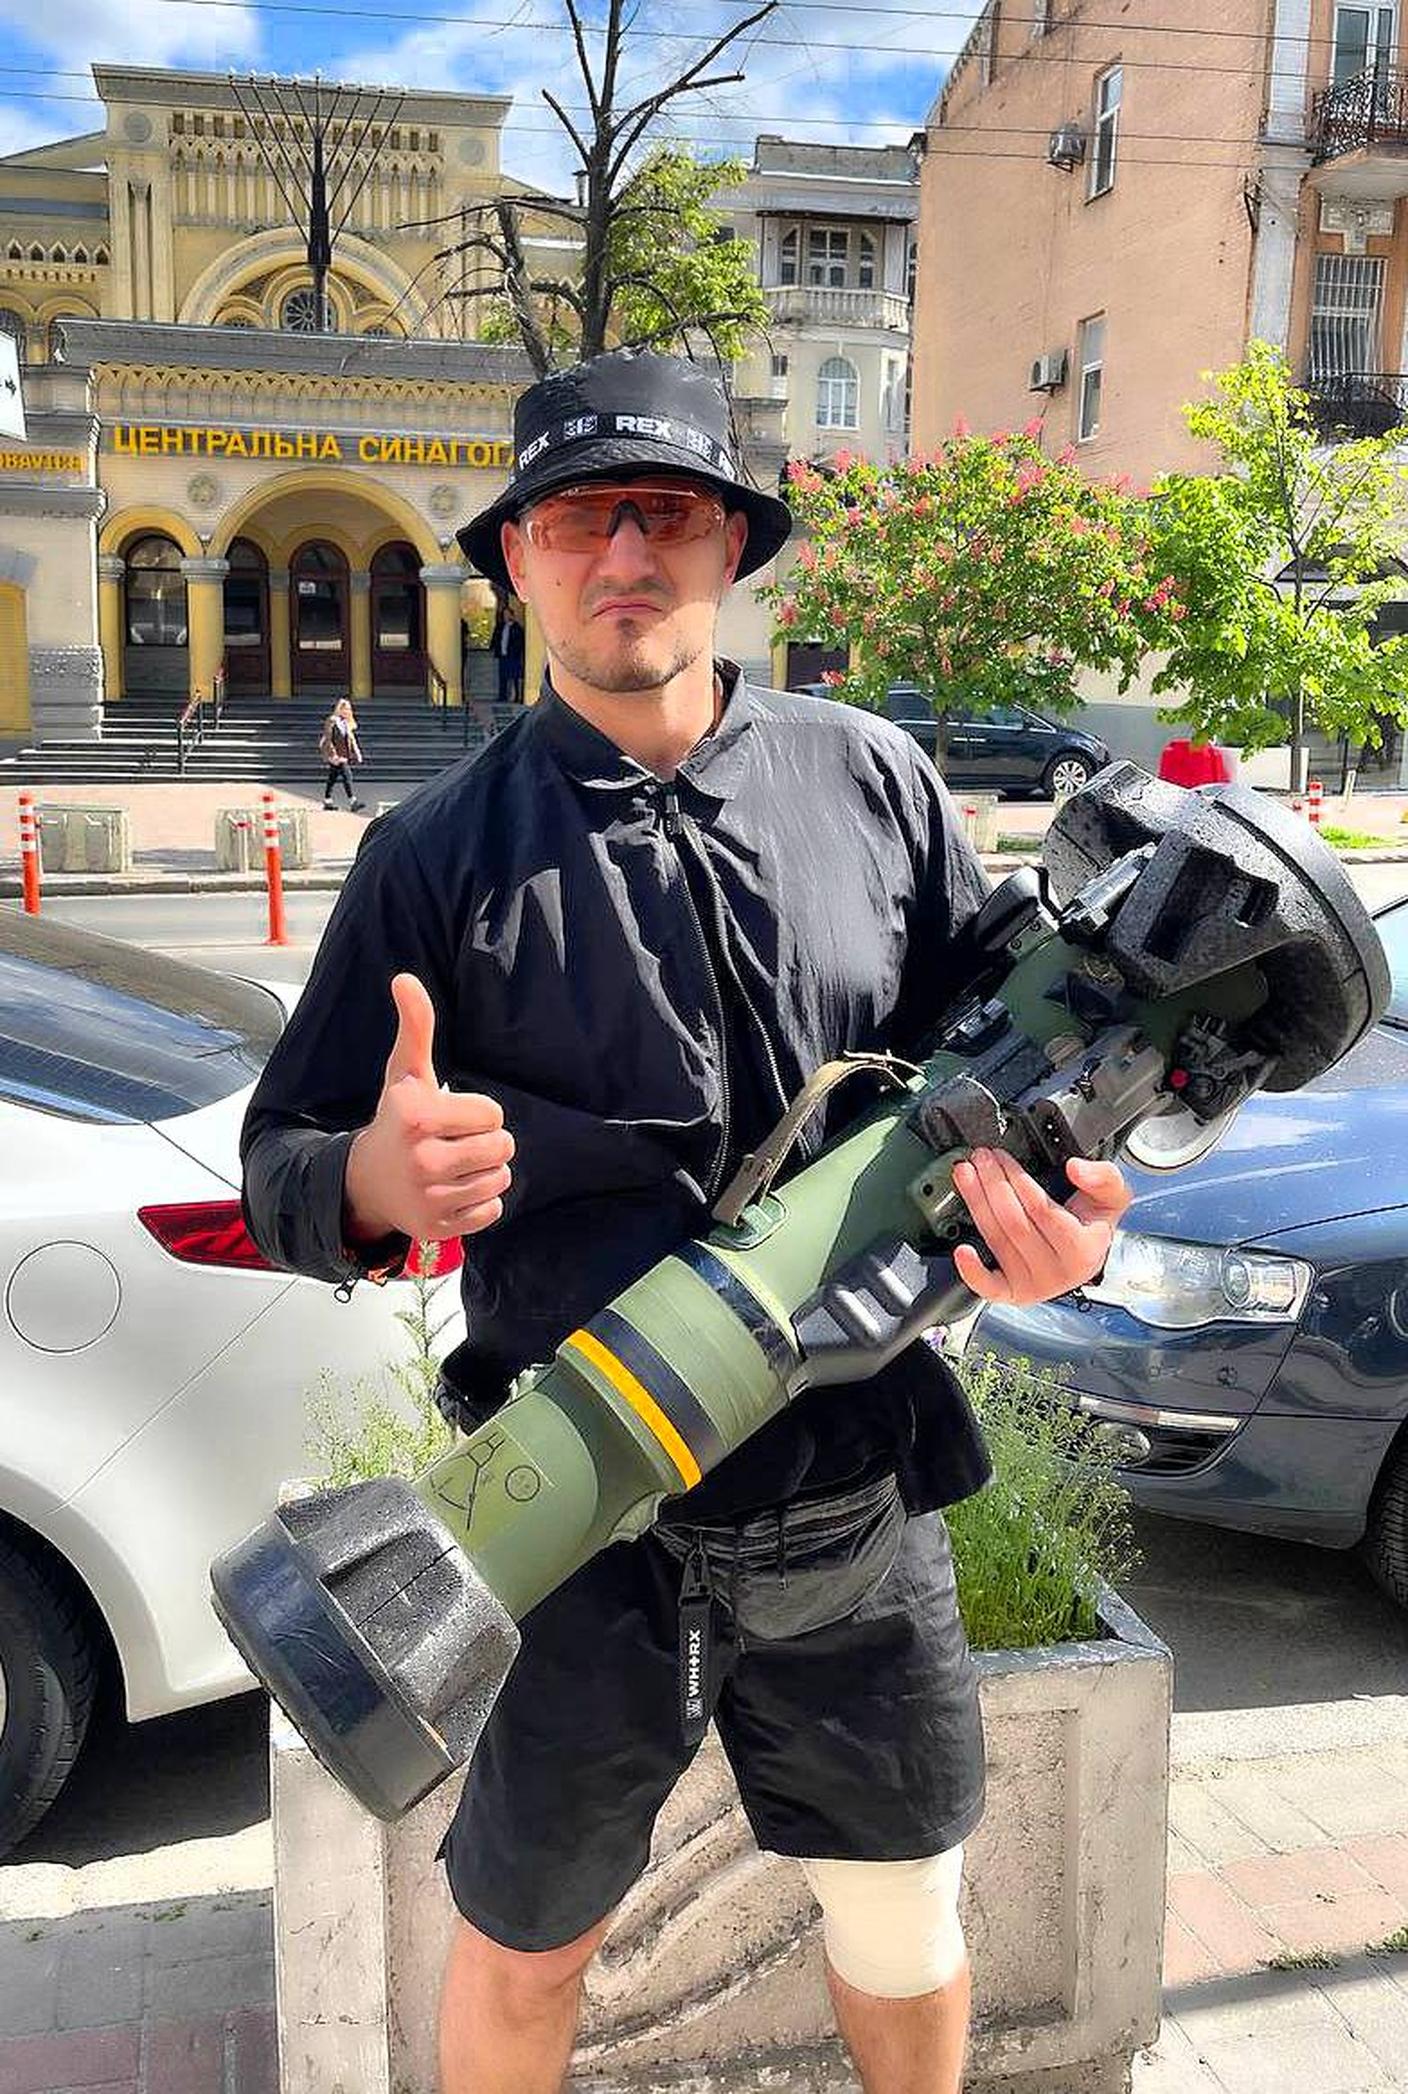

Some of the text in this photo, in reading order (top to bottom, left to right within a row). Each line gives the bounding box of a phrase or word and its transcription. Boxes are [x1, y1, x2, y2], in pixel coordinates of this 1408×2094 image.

[115, 425, 515, 468] ЦЕНТРАЛЬНА СИНАГОГ
[519, 415, 671, 470] REX REX
